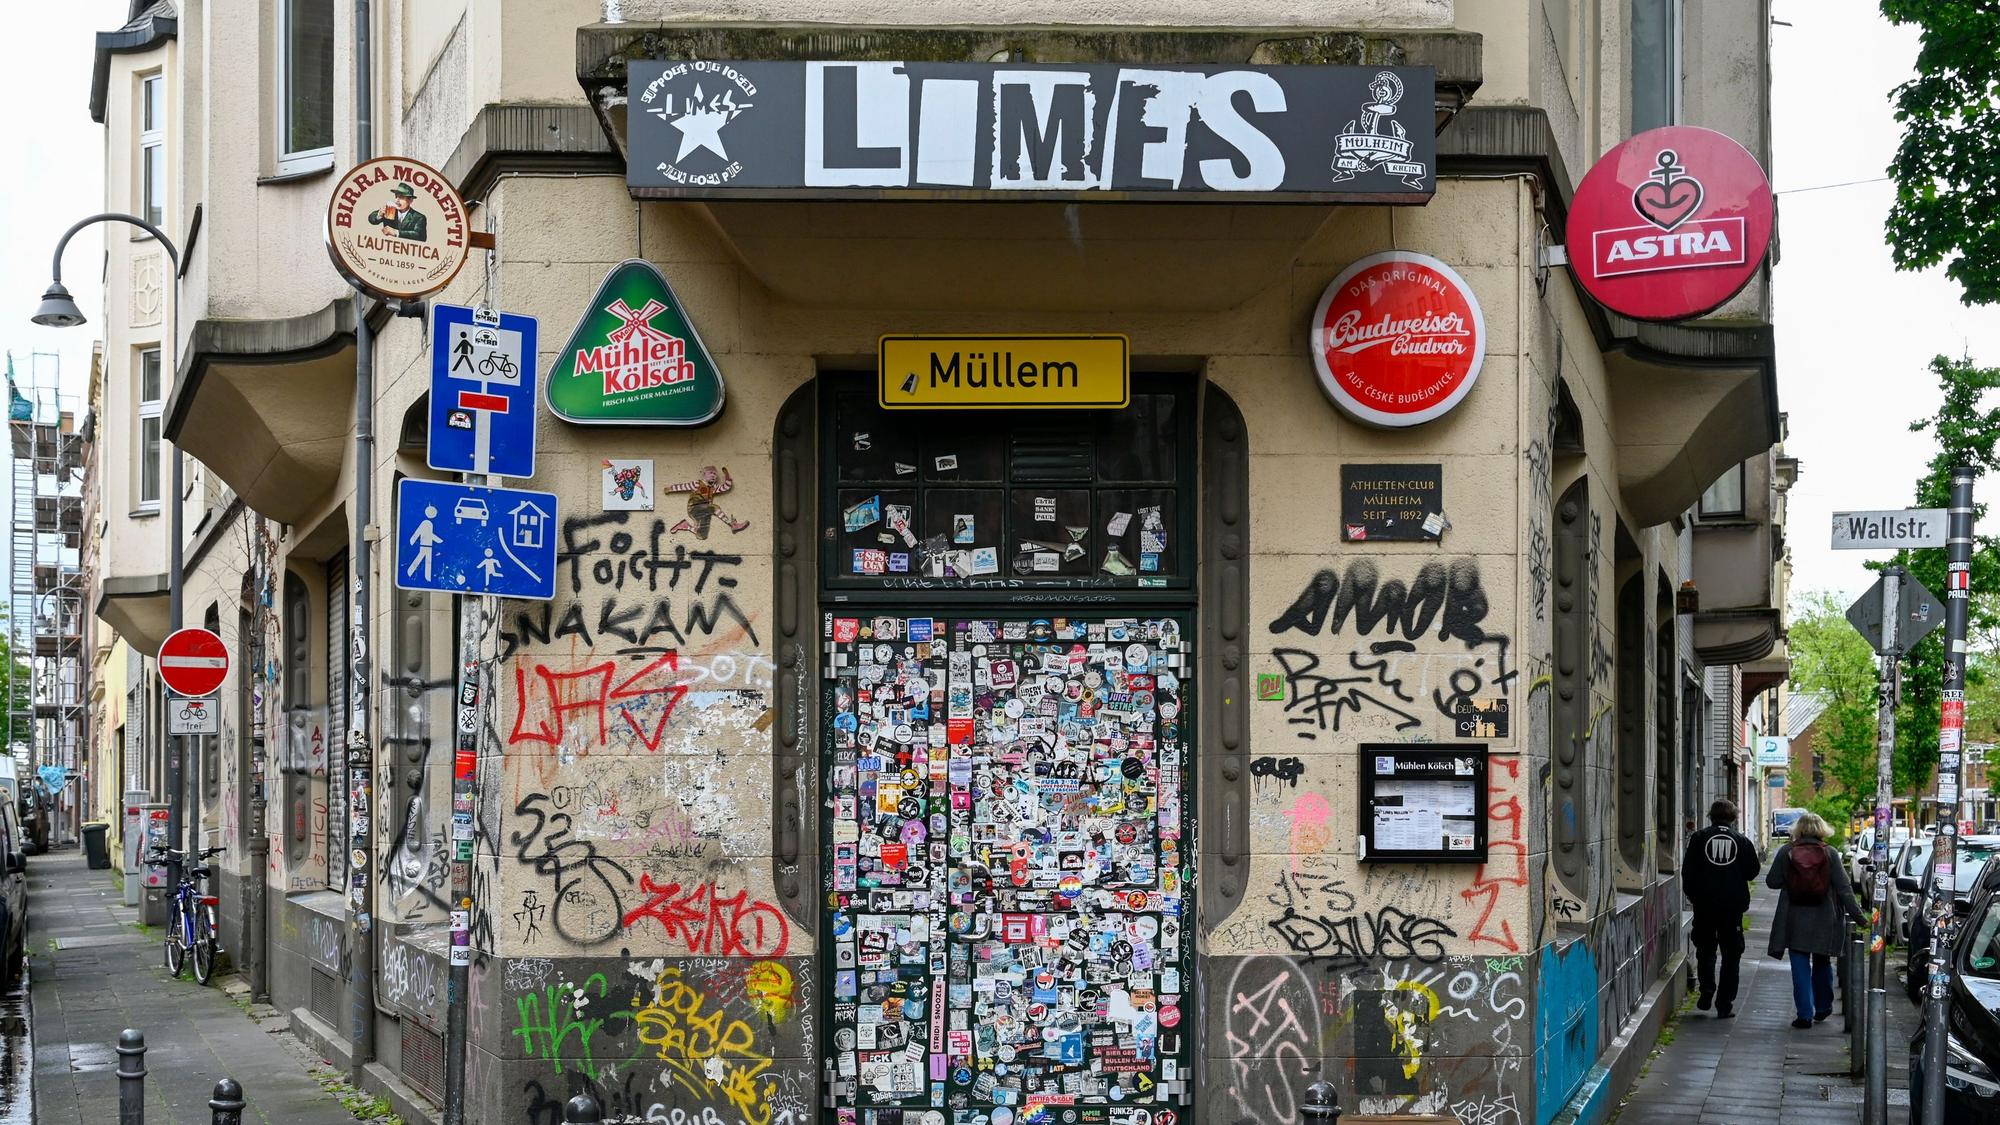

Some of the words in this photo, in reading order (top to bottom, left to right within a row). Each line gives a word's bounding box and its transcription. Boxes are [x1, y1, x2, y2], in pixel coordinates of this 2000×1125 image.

[804, 60, 1287, 191] LIMES
[335, 166, 389, 229] BIRRA
[393, 165, 463, 248] MORETTI
[357, 234, 440, 261] L'AUTENTICA
[1606, 230, 1732, 263] ASTRA
[368, 269, 399, 284] PREMIUM
[379, 257, 394, 267] DAL
[396, 259, 415, 270] 1859
[1350, 276, 1377, 297] DAS
[1382, 270, 1447, 297] ORIGINAL
[1329, 310, 1469, 349] Budweiser
[575, 338, 684, 375] Mühlen
[1391, 333, 1466, 356] Budvar
[604, 357, 694, 394] Kölsch
[929, 352, 1078, 388] Müllem
[1346, 371, 1366, 389] AUS
[602, 397, 625, 408] FRISCH
[626, 395, 639, 403] AUS
[640, 392, 653, 400] DER
[654, 385, 695, 398] MALZMÜHLE
[1363, 493, 1422, 505] MÜLHEIM
[1362, 511, 1387, 520] SEIT
[1400, 511, 1422, 520] 1892
[1848, 515, 1931, 540] Wallstr.
[1394, 761, 1426, 770] Mühlen
[1427, 761, 1454, 770] Kölsch
